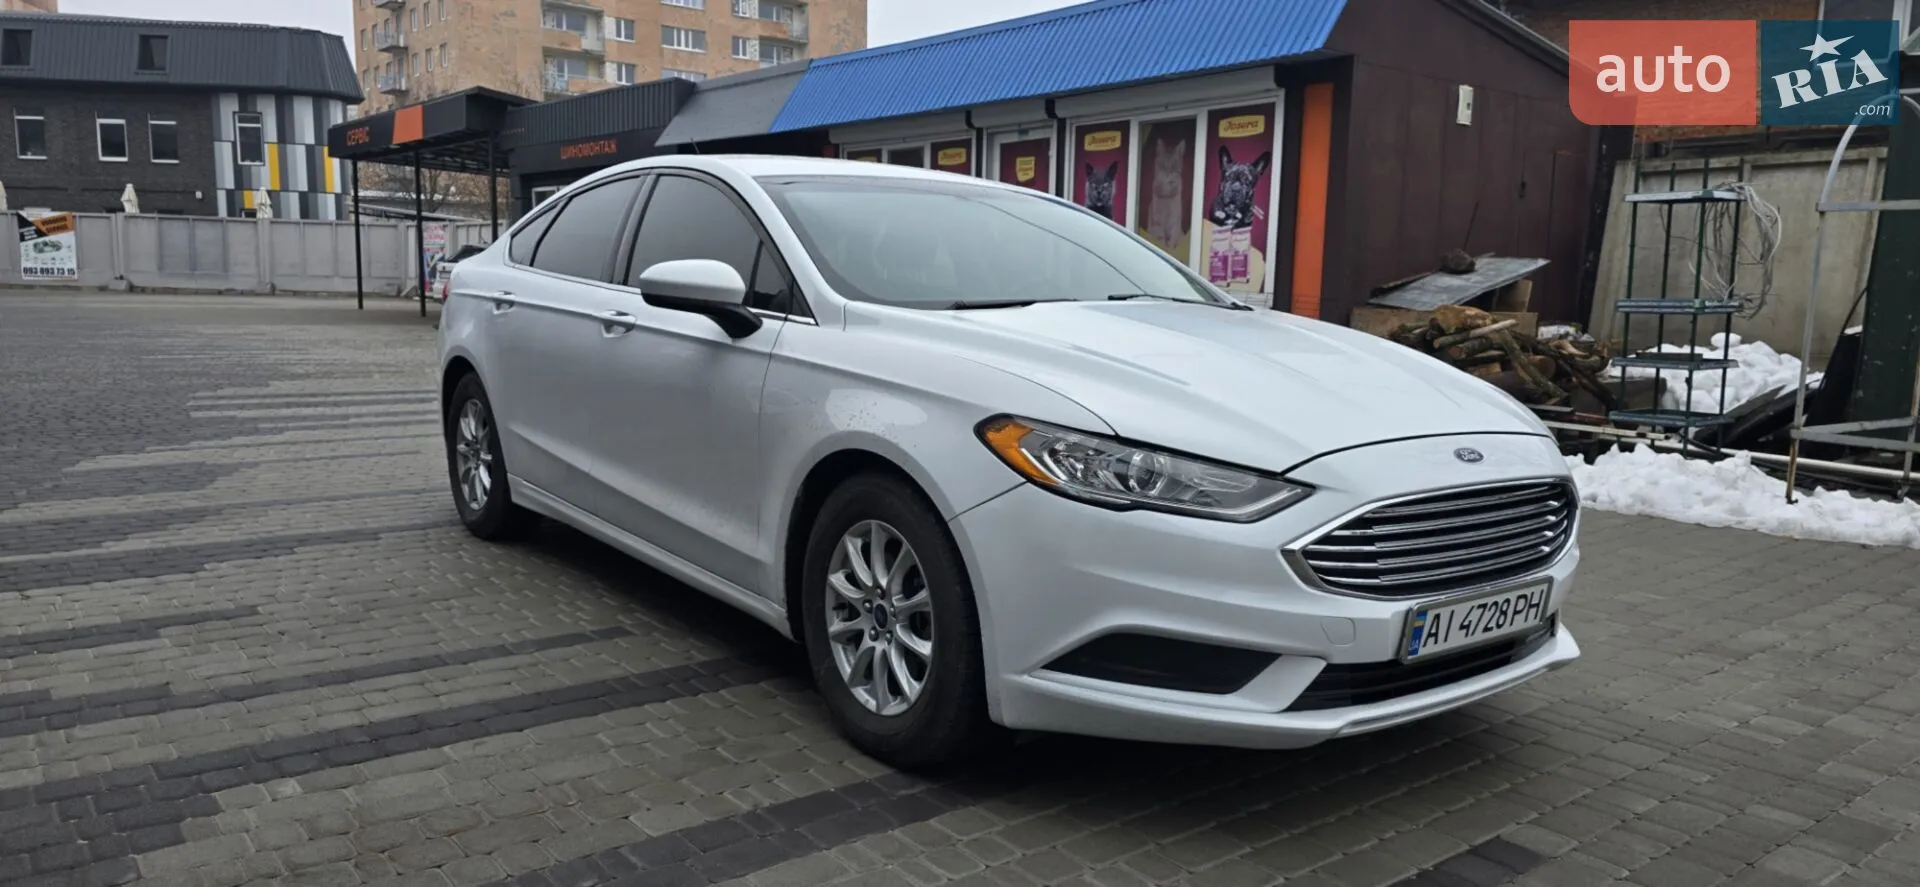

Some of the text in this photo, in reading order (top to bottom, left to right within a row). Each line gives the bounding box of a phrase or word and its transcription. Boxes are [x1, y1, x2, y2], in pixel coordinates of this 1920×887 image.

[1223, 120, 1259, 132] Josera
[1087, 134, 1117, 146] Josera
[560, 139, 617, 159] ШИНОМОНТАЖ
[23, 267, 38, 275] 093
[56, 267, 66, 276] 73
[1422, 590, 1545, 648] AI 4728 PH
